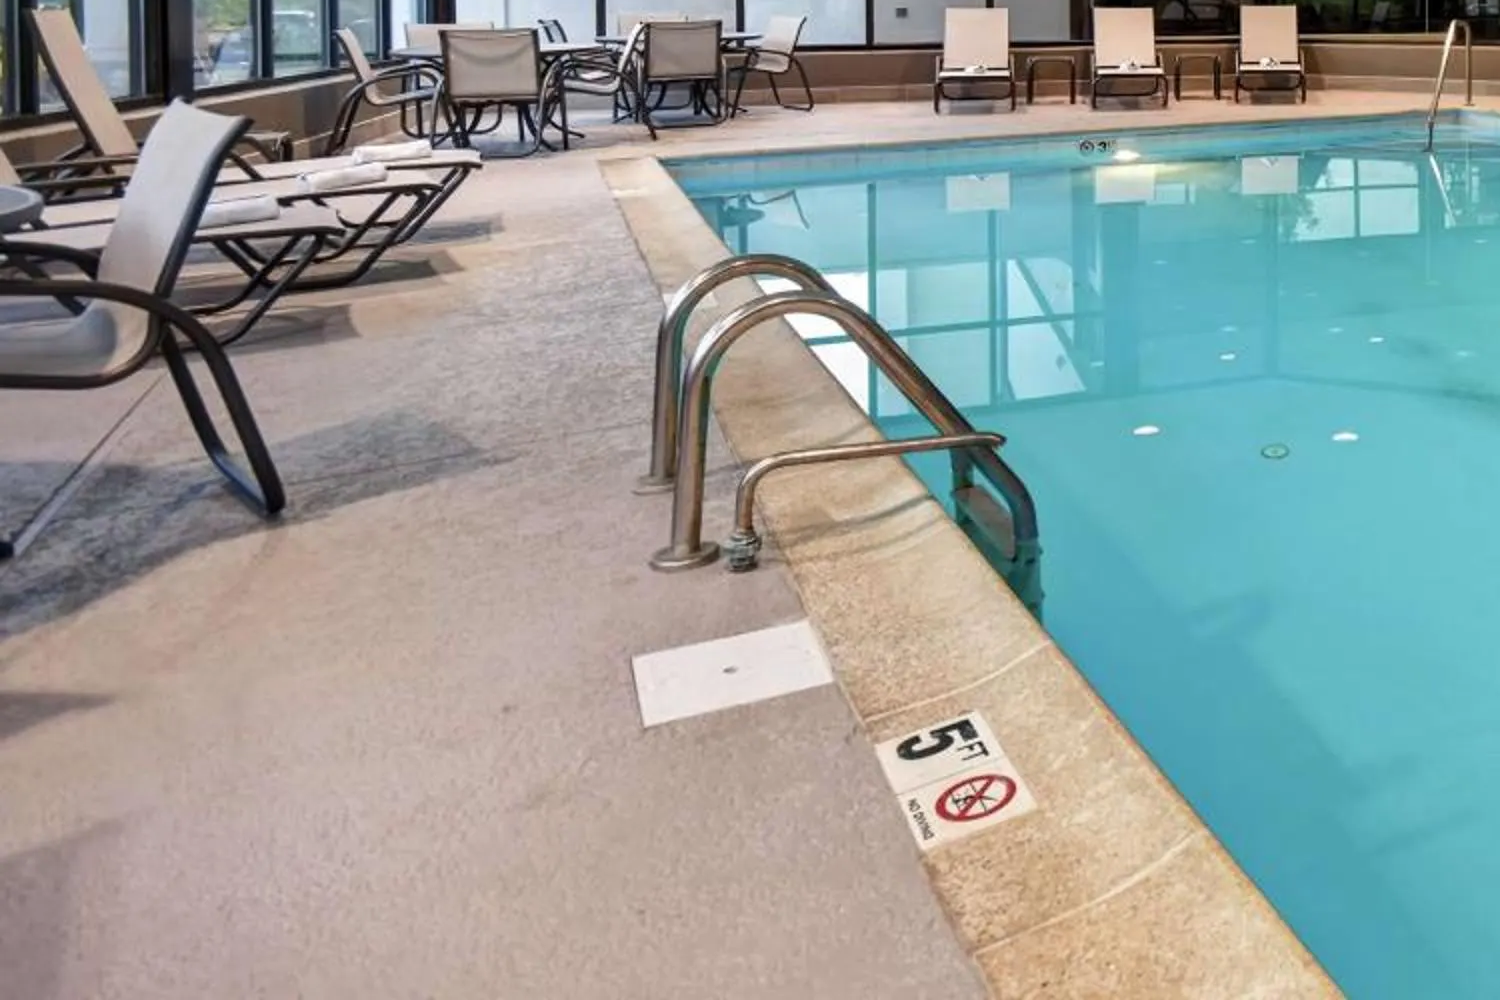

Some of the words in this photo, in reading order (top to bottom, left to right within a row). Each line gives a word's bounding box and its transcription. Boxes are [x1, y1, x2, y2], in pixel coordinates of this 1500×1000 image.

[895, 718, 979, 761] 5
[955, 741, 990, 762] FT
[908, 798, 921, 812] NO
